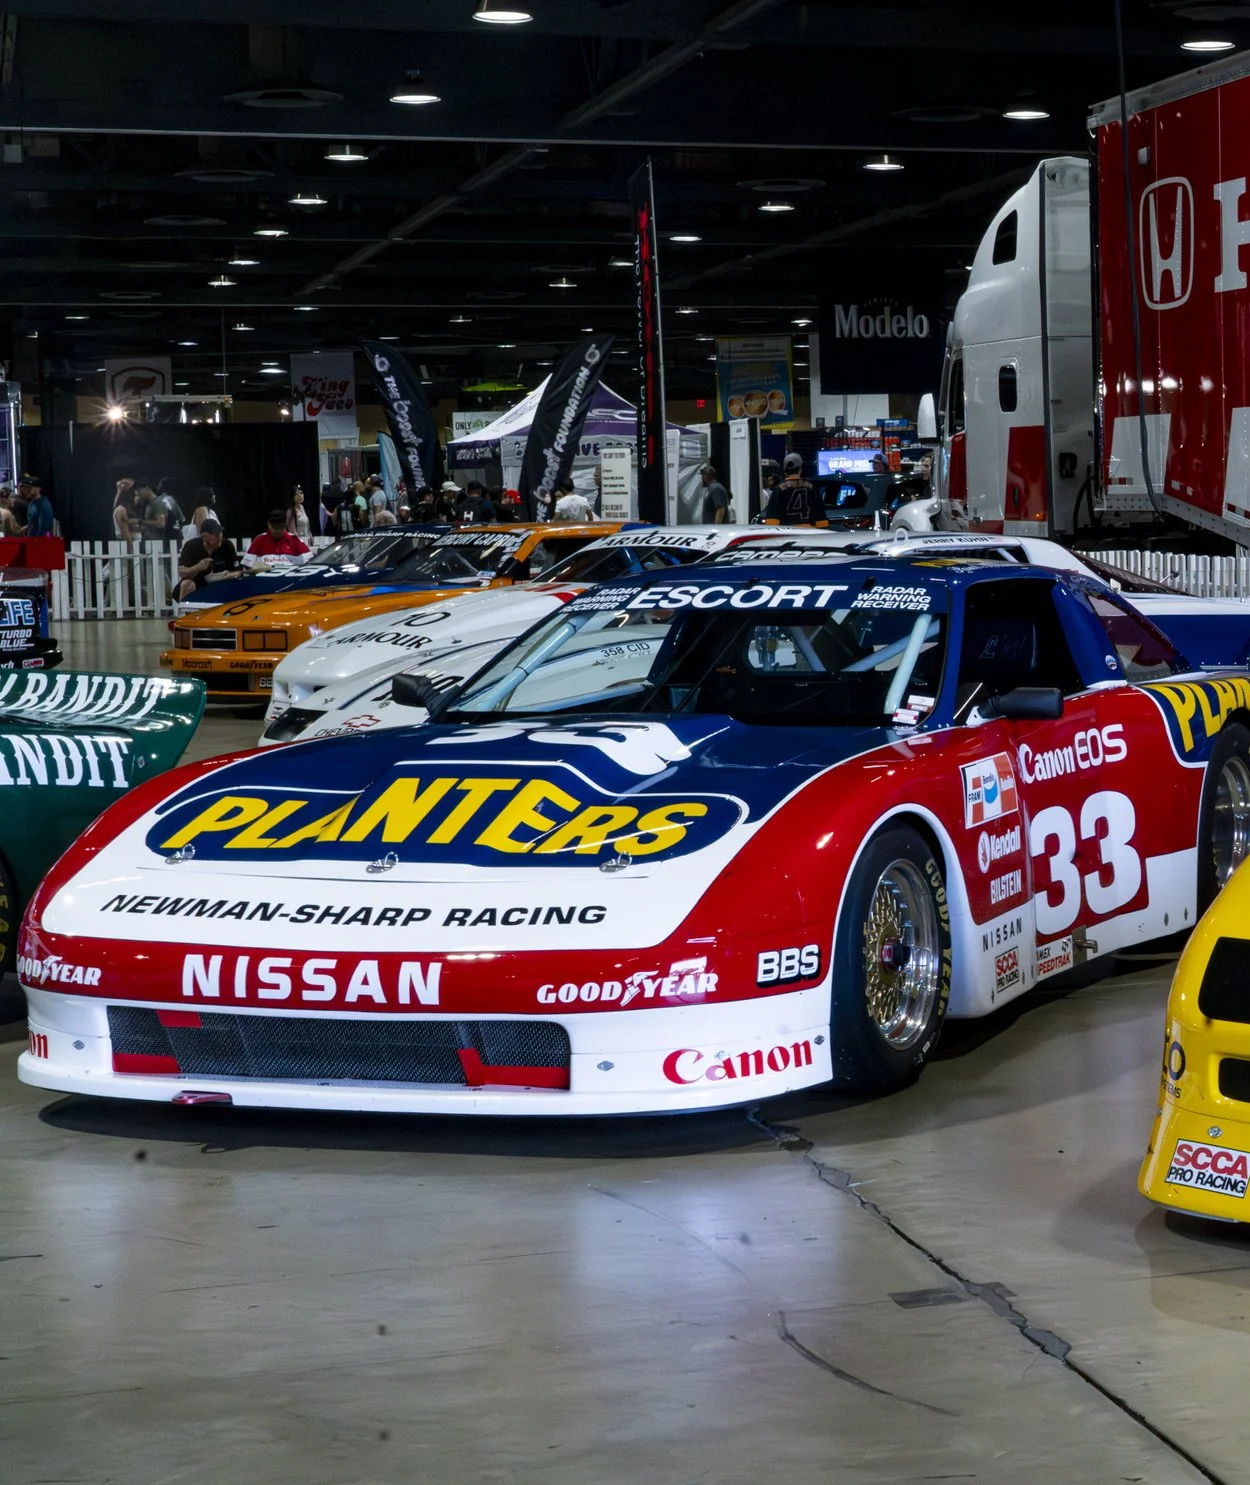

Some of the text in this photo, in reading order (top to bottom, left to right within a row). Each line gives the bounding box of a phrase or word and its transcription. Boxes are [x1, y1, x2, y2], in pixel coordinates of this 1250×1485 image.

[834, 303, 930, 340] Modelo
[553, 365, 592, 454] FOUNDATION
[602, 535, 698, 548] ARMOUR
[922, 536, 990, 545] JERRY KUHN
[595, 587, 642, 596] RADAR
[626, 585, 850, 610] ESCORT
[850, 600, 931, 611] RECEIVER
[856, 592, 932, 604] WARNING
[870, 585, 927, 595] RADAR
[0, 629, 33, 640] TURBO
[391, 610, 453, 627] 10
[331, 631, 433, 650] ARMOUR
[600, 641, 651, 659] 358 CID
[10, 672, 164, 720] BANDIT
[1018, 723, 1128, 785] Canon EOS
[160, 777, 708, 856] PLANTERS
[989, 824, 1022, 862] Kendall
[1029, 789, 1142, 936] 33
[990, 868, 1022, 905] BILSTEIN
[101, 894, 607, 927] NEWMAN-SHARP RACING
[982, 917, 1022, 952] NISSAN
[181, 952, 443, 1005] NISSAN
[757, 944, 820, 985] BBS
[995, 953, 1018, 977] SCCA
[663, 1039, 813, 1085] Canon
[1173, 1143, 1249, 1179] SCCA
[1167, 1165, 1247, 1194] PRO RACING
